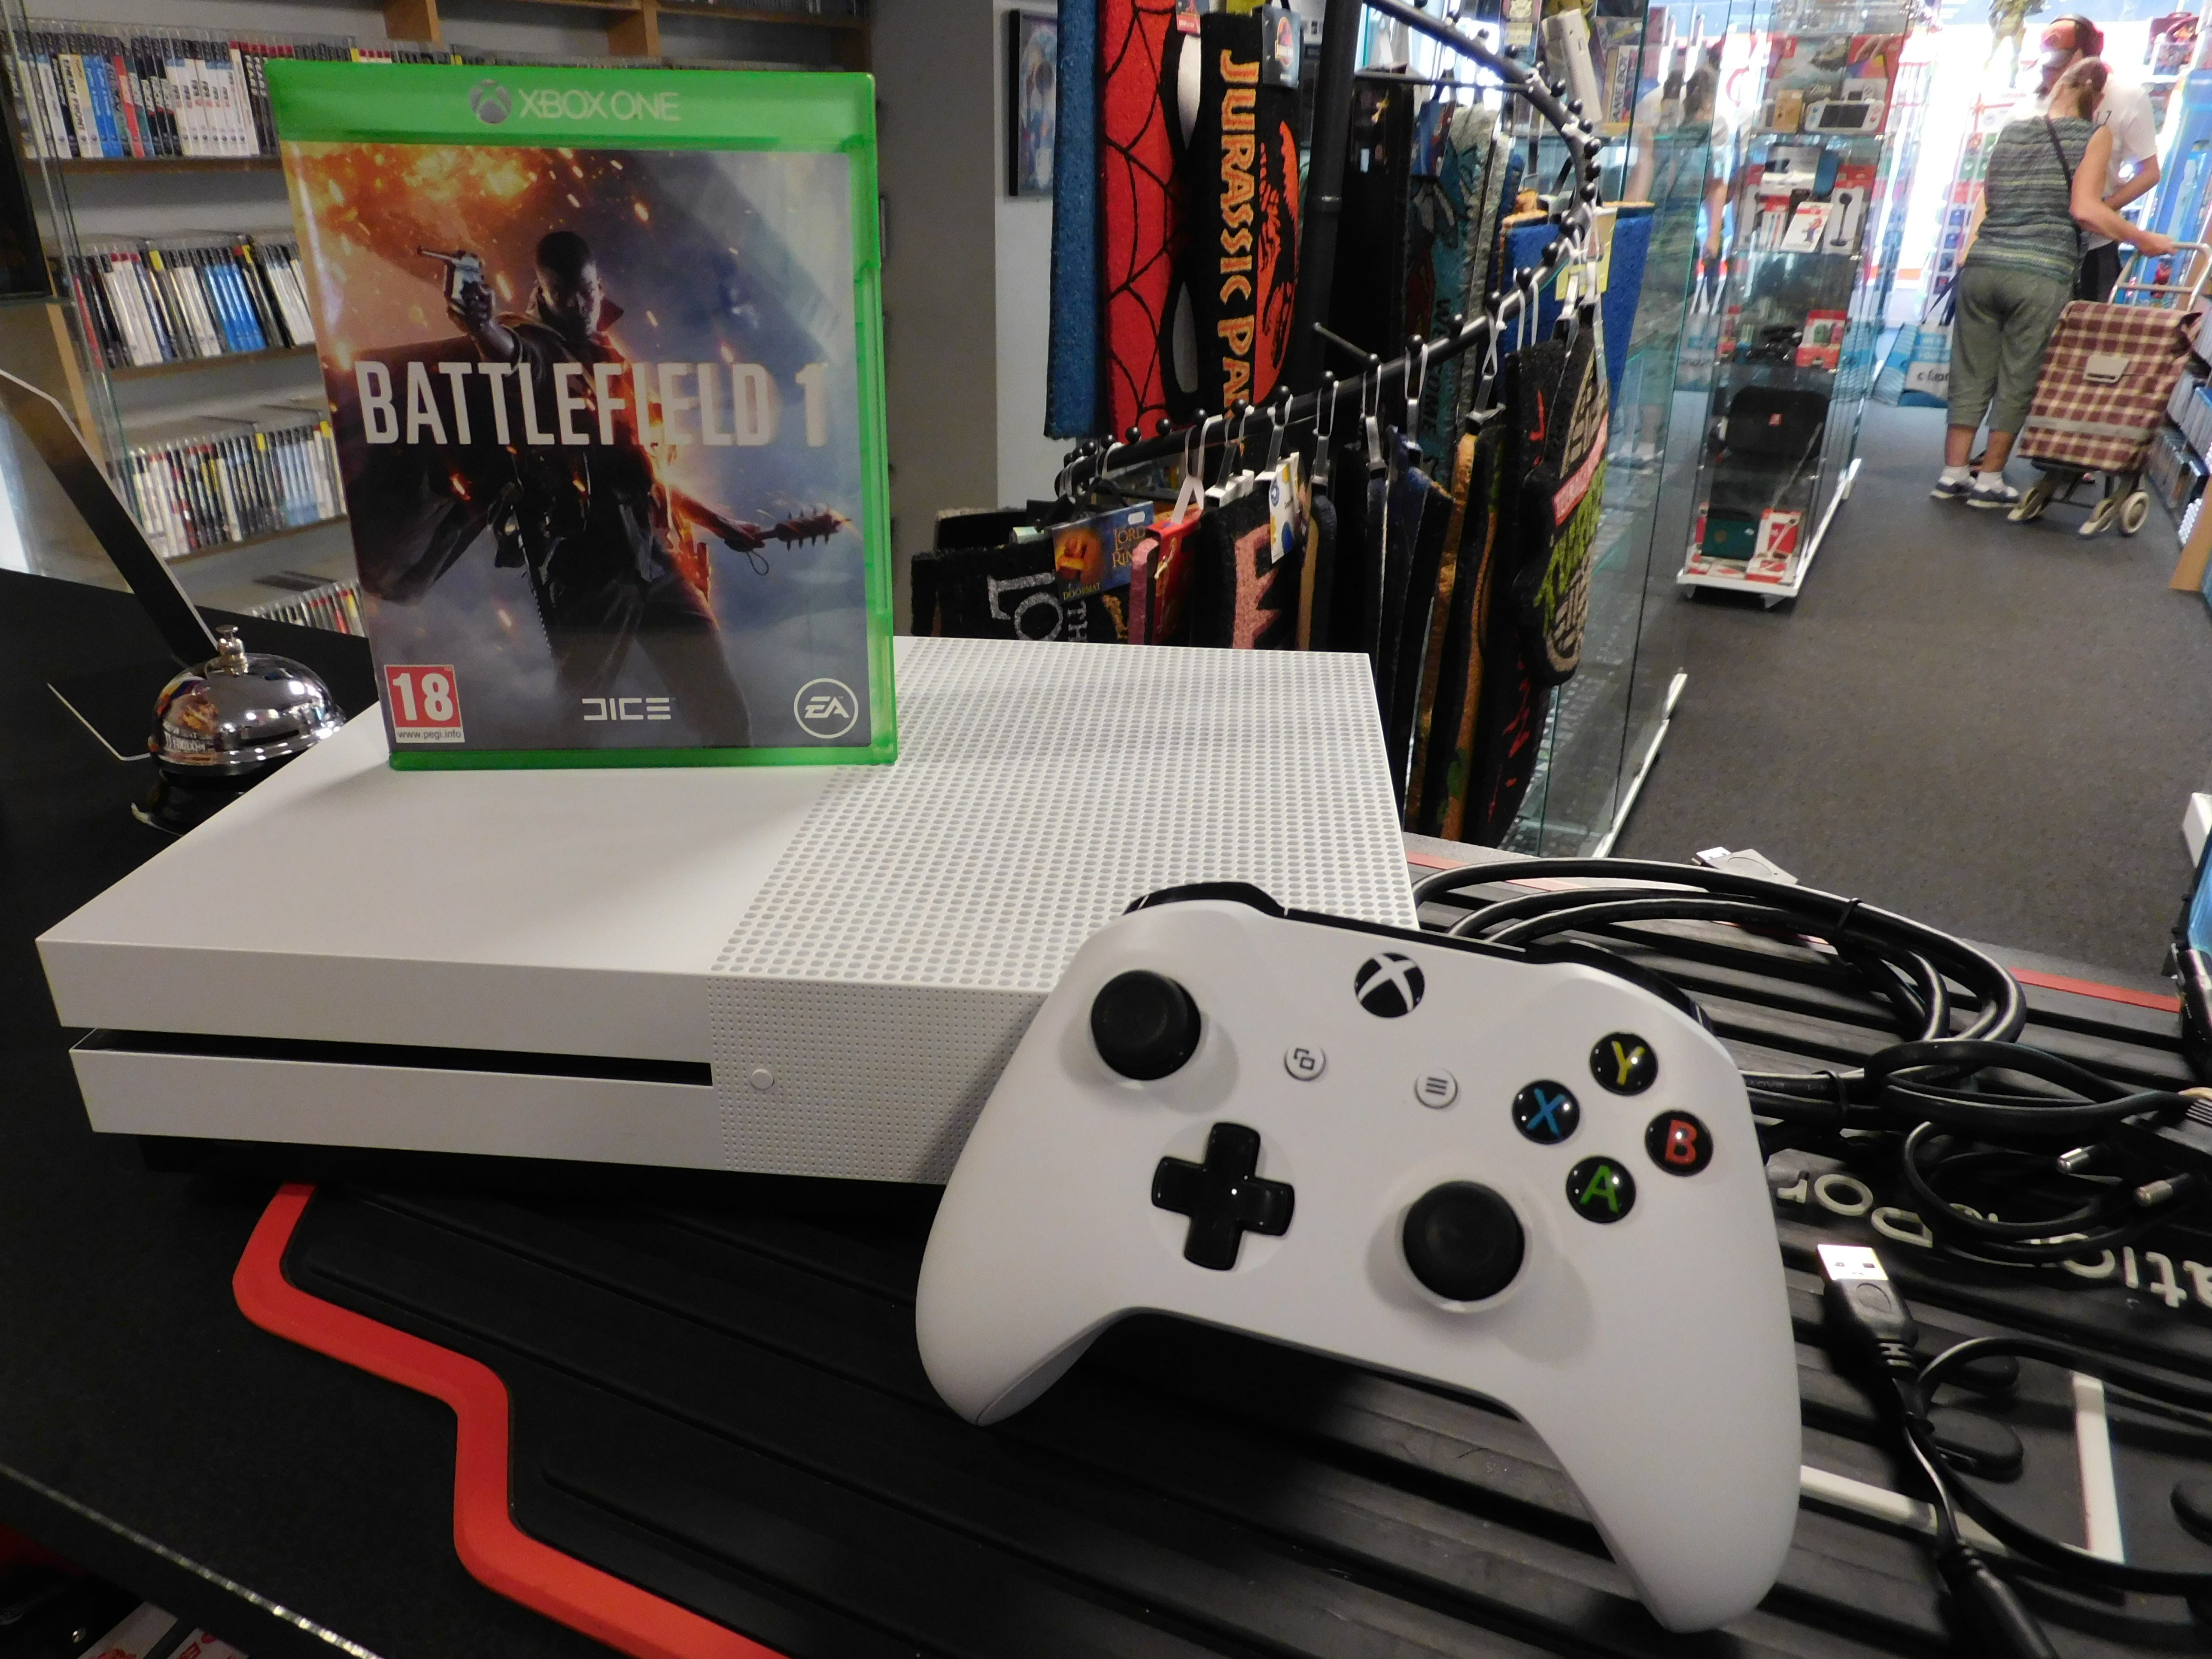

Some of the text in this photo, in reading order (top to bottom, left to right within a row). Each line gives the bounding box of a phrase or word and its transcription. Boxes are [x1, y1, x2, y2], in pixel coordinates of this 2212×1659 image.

[518, 88, 681, 121] XBOX ONE
[1217, 49, 1260, 409] JURASSIC PA
[356, 360, 830, 447] BATTLEFIELD 1
[1112, 549, 1133, 568] RIN
[987, 571, 1063, 641] LO
[1063, 582, 1101, 600] DOORMAT
[392, 673, 453, 721] 18
[582, 697, 671, 720] DICE
[804, 695, 850, 719] EA
[398, 729, 462, 741] www.pegi.info
[1611, 1041, 1644, 1085] Y
[1527, 1088, 1565, 1134] X
[1665, 1119, 1696, 1164] B
[1580, 1165, 1620, 1212] A
